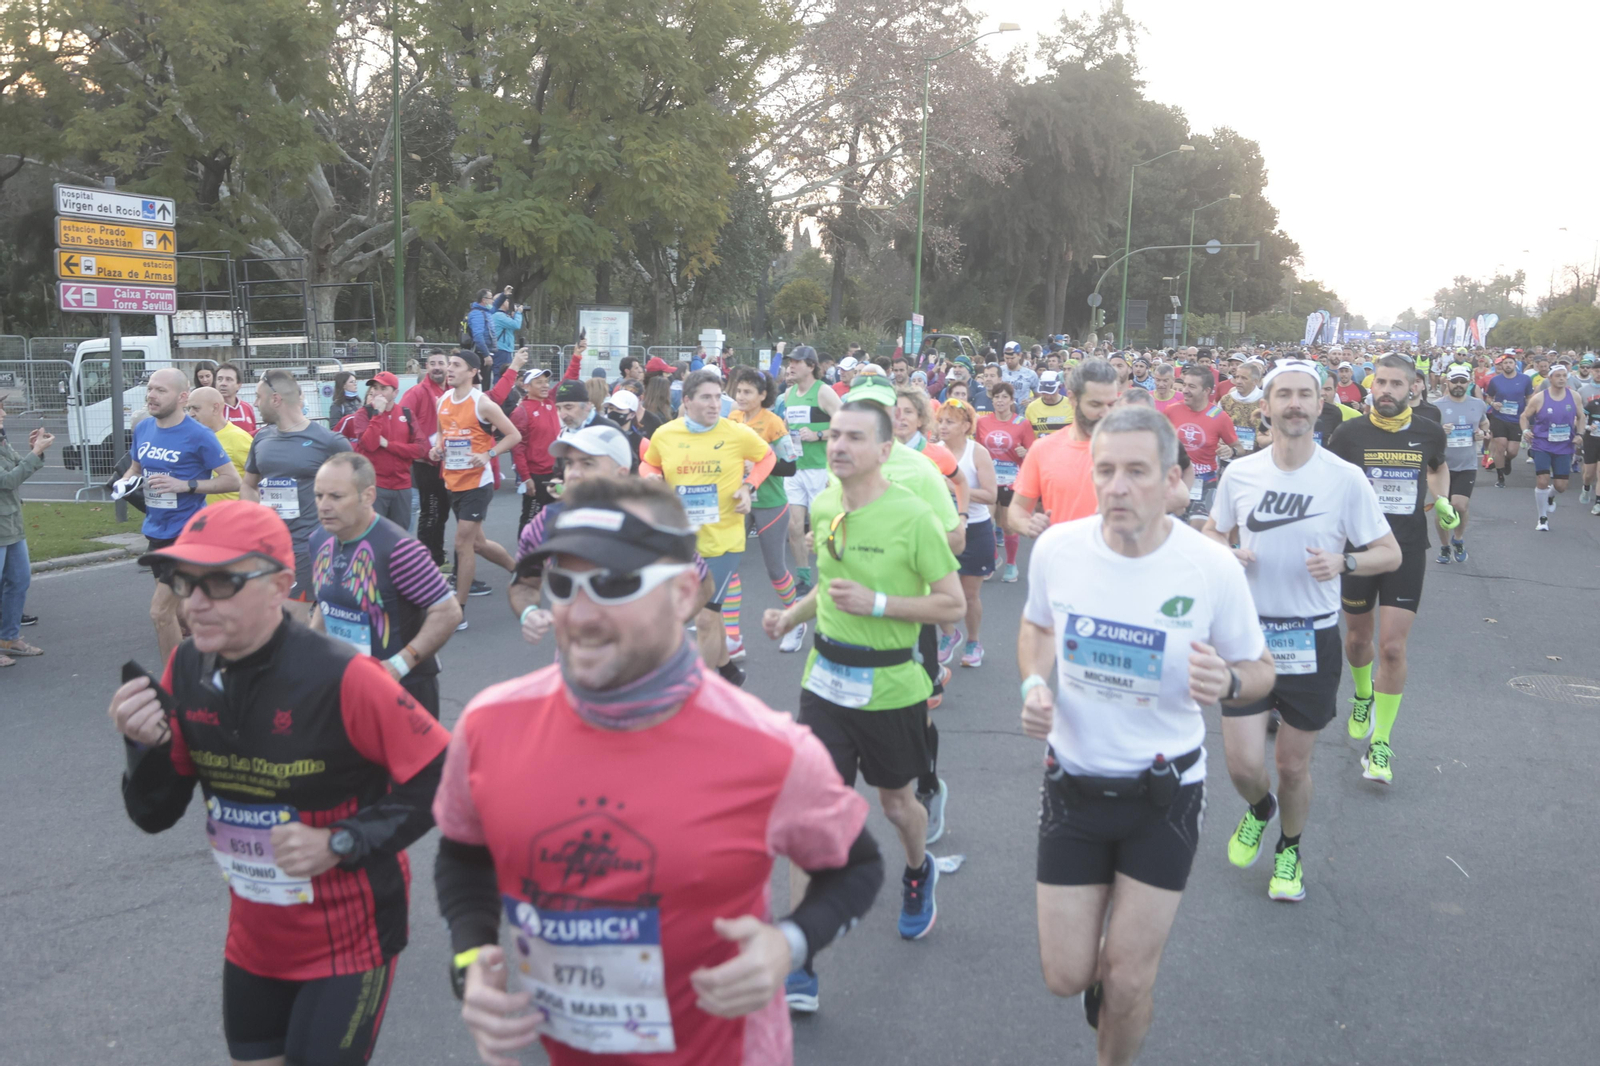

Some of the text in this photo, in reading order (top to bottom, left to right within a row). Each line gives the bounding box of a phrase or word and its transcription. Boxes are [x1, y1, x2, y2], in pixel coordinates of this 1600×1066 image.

[61, 190, 94, 200] hospital
[62, 198, 141, 216] Virgen del Rocío
[63, 226, 126, 236] estación Prado
[64, 234, 132, 248] San Sebastián
[142, 261, 172, 269] estación
[97, 267, 172, 280] Plaza de Armas
[114, 288, 173, 300] Caixa Forum
[112, 299, 173, 310] Torre Sevilla
[147, 446, 181, 462] asics
[676, 465, 722, 474] SEVILLA
[687, 486, 712, 494] ZURICH
[1258, 490, 1314, 517] RUN
[329, 606, 361, 622] ZURICH
[1267, 620, 1306, 631] ZURICH
[1096, 624, 1154, 646] ZURICH
[1092, 652, 1132, 670] 10318
[231, 754, 250, 771] La
[252, 757, 326, 779] Negrilla
[223, 807, 284, 826] ZURICH
[230, 838, 265, 856] 6316
[232, 860, 276, 879] ANTONIO
[542, 917, 639, 942] ZURICH
[571, 1001, 618, 1018] MARI
[624, 1004, 647, 1018] 13
